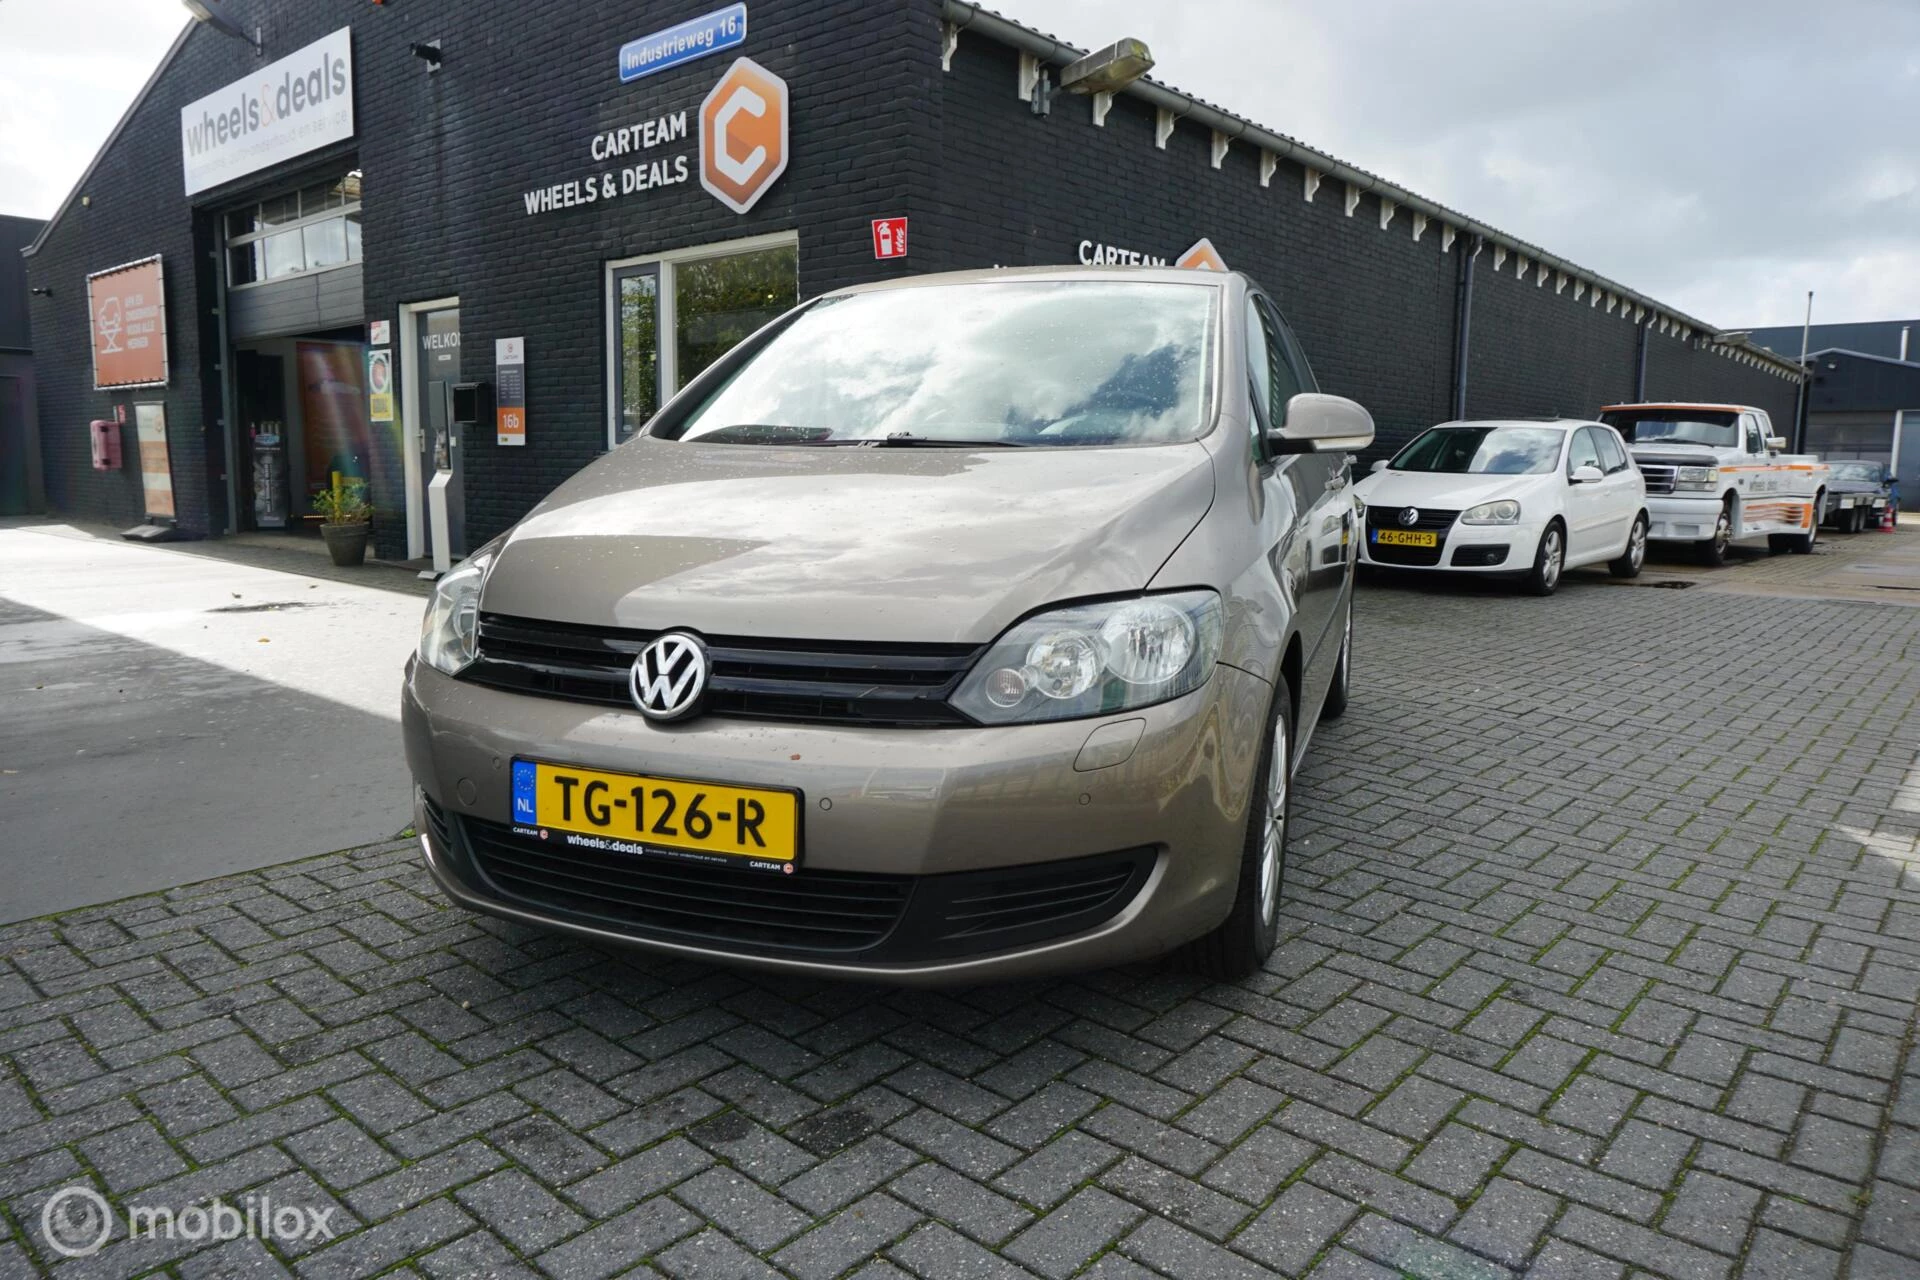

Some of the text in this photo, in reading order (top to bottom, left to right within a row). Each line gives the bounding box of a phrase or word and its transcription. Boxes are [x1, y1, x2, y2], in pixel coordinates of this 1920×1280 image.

[627, 29, 714, 69] Industrieweg
[591, 111, 687, 160] CARTEAM
[524, 155, 688, 215] WHEELS & DEALS
[422, 332, 461, 350] WELKO
[503, 414, 519, 429] 16b
[1380, 532, 1432, 545] 46-GHH-3
[517, 798, 533, 813] NL
[554, 775, 766, 847] TG-126-R
[512, 826, 538, 836] CARTEAM
[567, 834, 643, 855] wheels&deals
[750, 861, 781, 871] CARTEAM
